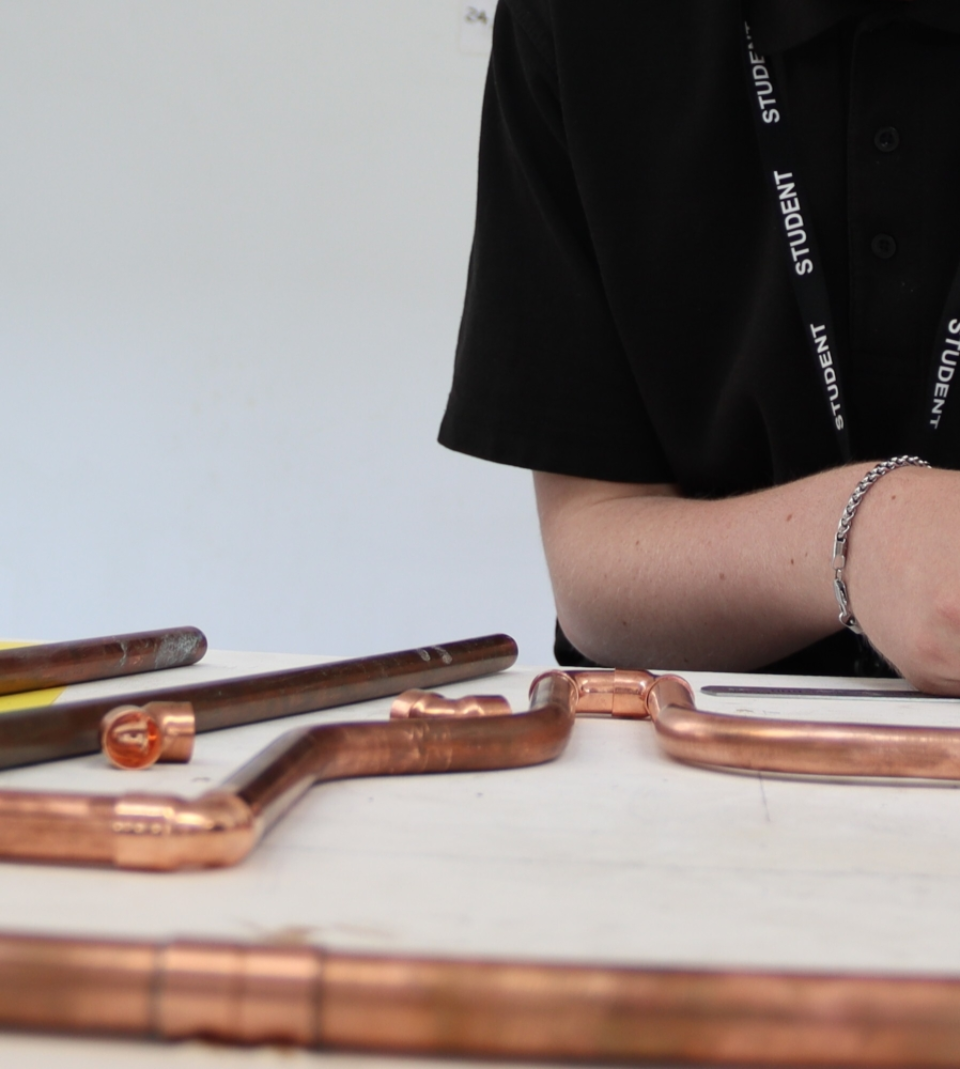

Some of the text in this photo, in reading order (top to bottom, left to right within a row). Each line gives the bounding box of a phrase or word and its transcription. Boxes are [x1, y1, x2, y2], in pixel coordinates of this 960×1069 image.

[745, 21, 780, 123] STUDE
[774, 170, 813, 275] STUDENT
[810, 323, 845, 430] STUDENT
